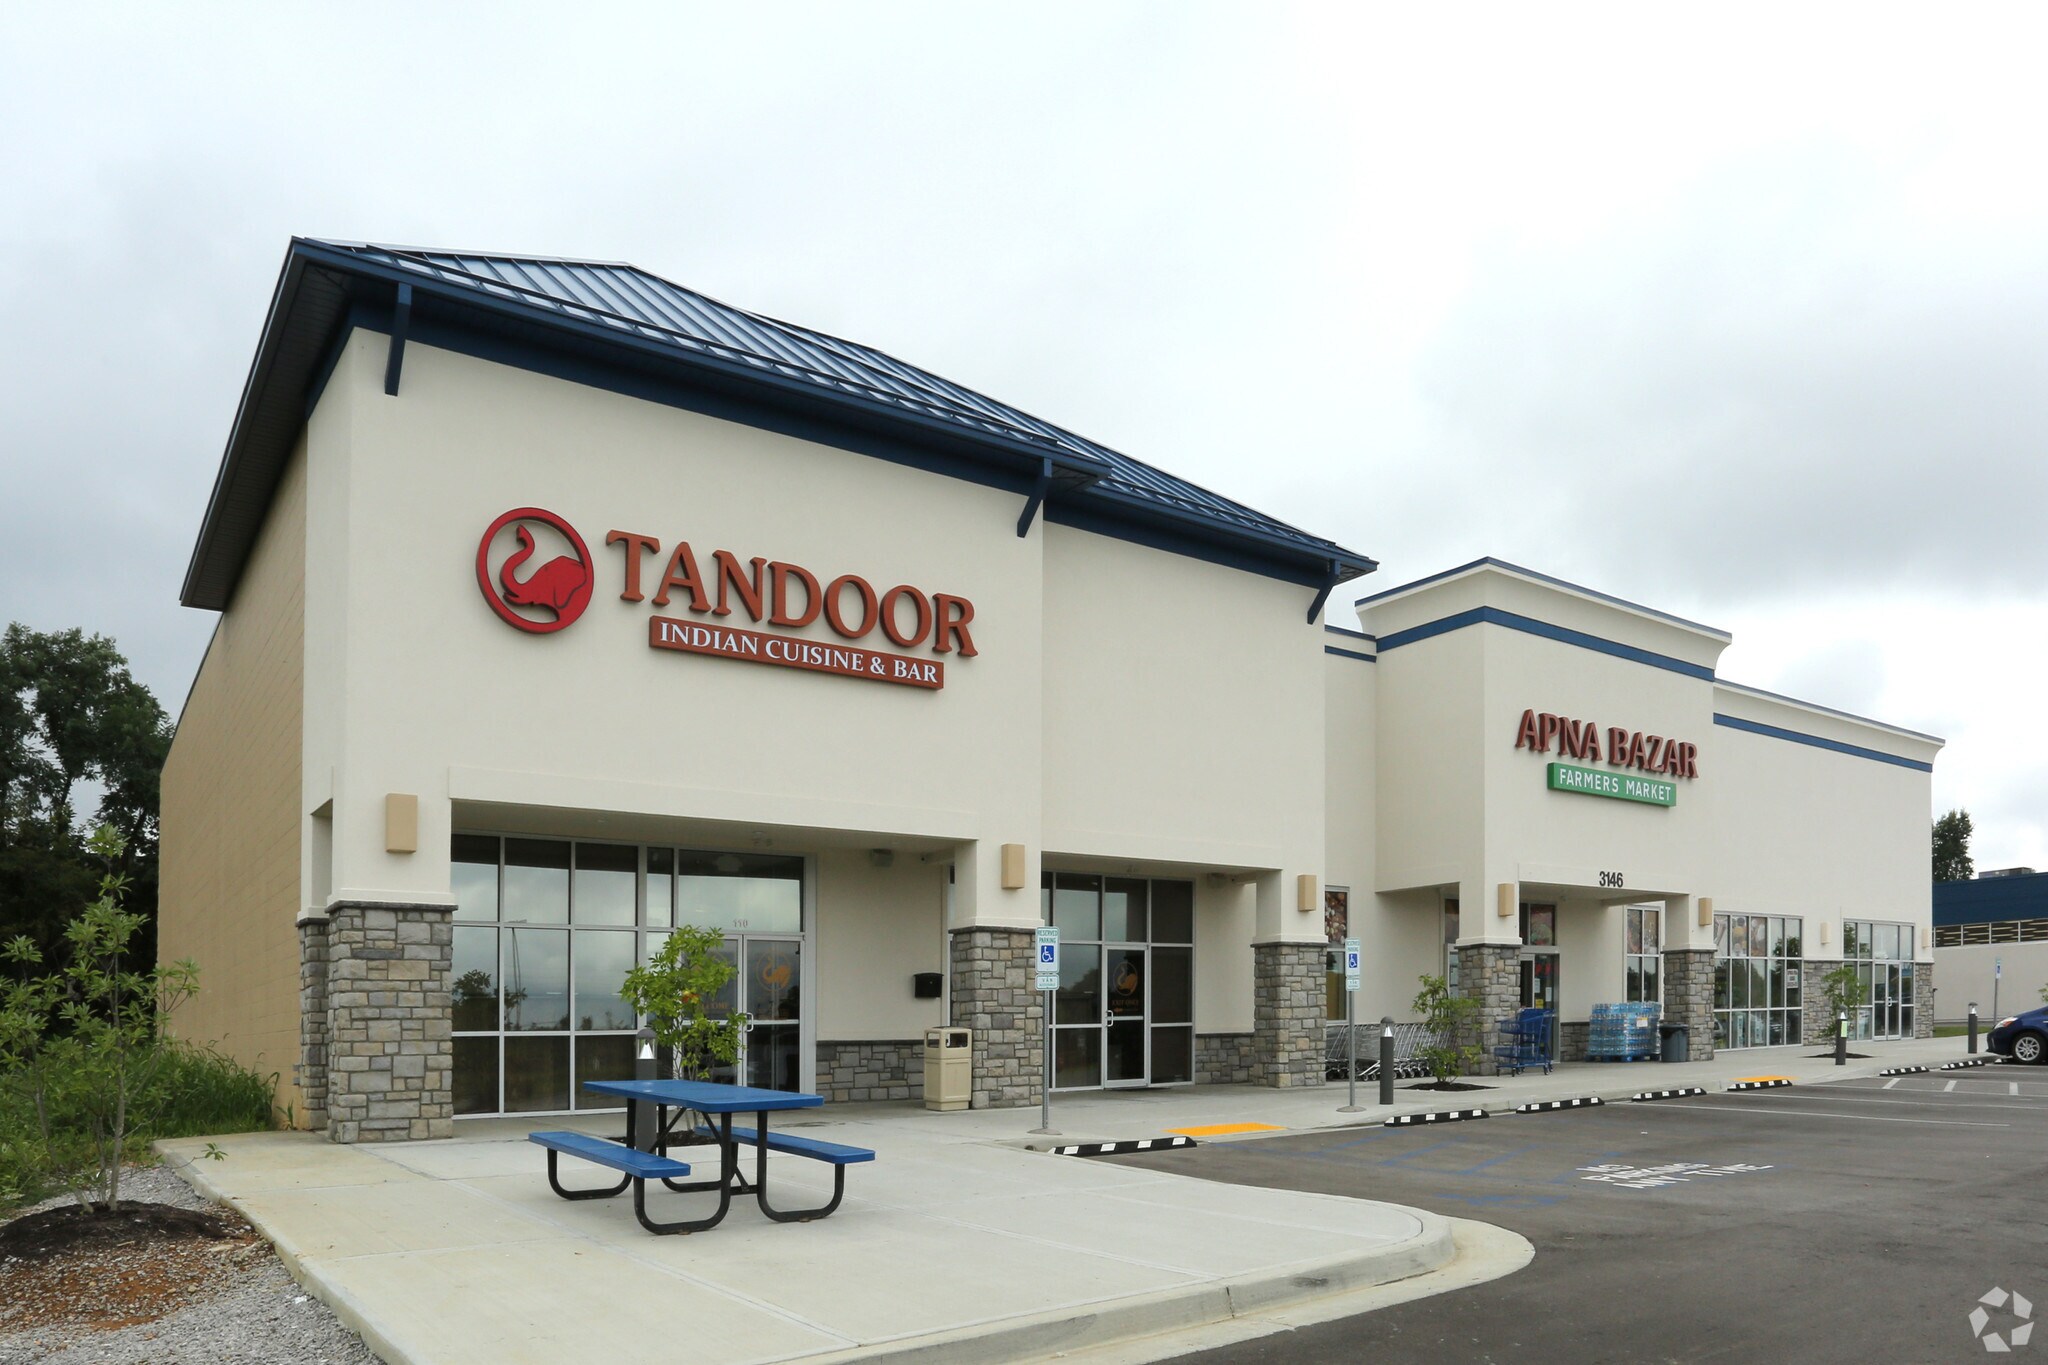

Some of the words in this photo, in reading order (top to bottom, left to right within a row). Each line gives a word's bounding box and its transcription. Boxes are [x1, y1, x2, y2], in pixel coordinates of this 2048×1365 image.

[605, 529, 978, 657] TANDOOR
[659, 622, 759, 655] INDIAN
[764, 638, 864, 673] CUISINE
[869, 656, 886, 674] &
[893, 659, 937, 683] BAR
[1515, 709, 1603, 761] APNA
[1608, 726, 1699, 778] BAZAR
[1559, 768, 1619, 793] FARMERS
[1626, 780, 1671, 801] MARKET
[1599, 870, 1623, 888] 3146
